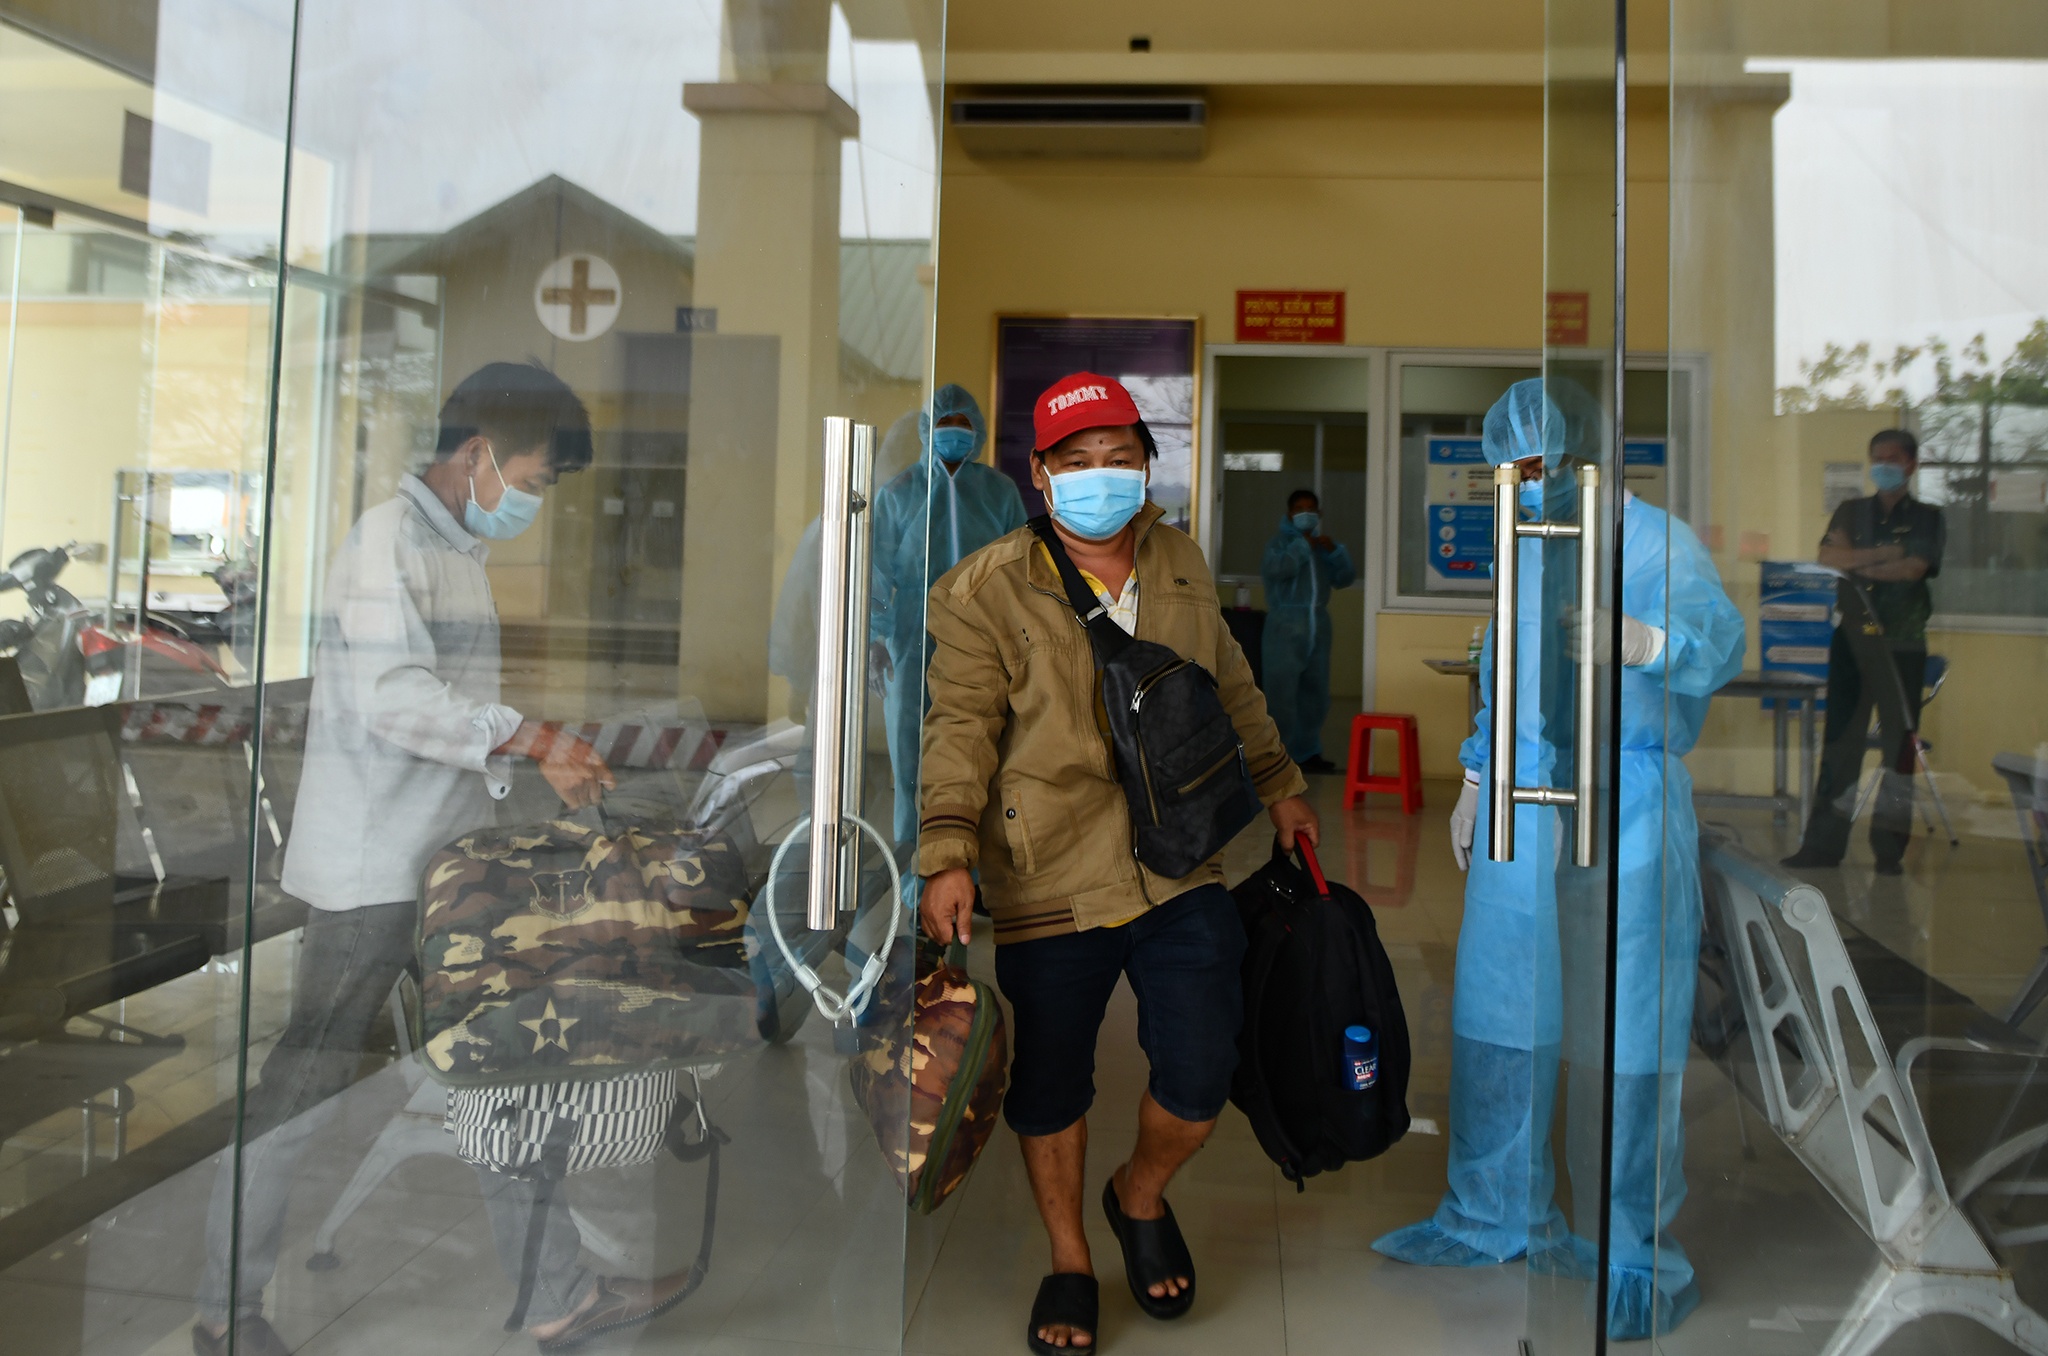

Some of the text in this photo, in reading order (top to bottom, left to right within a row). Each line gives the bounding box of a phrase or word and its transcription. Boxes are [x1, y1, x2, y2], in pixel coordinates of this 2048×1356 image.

[1244, 316, 1335, 328] BODY CHECK ROOM
[1048, 385, 1108, 416] TOMMY
[1354, 1063, 1377, 1076] CLEAR
